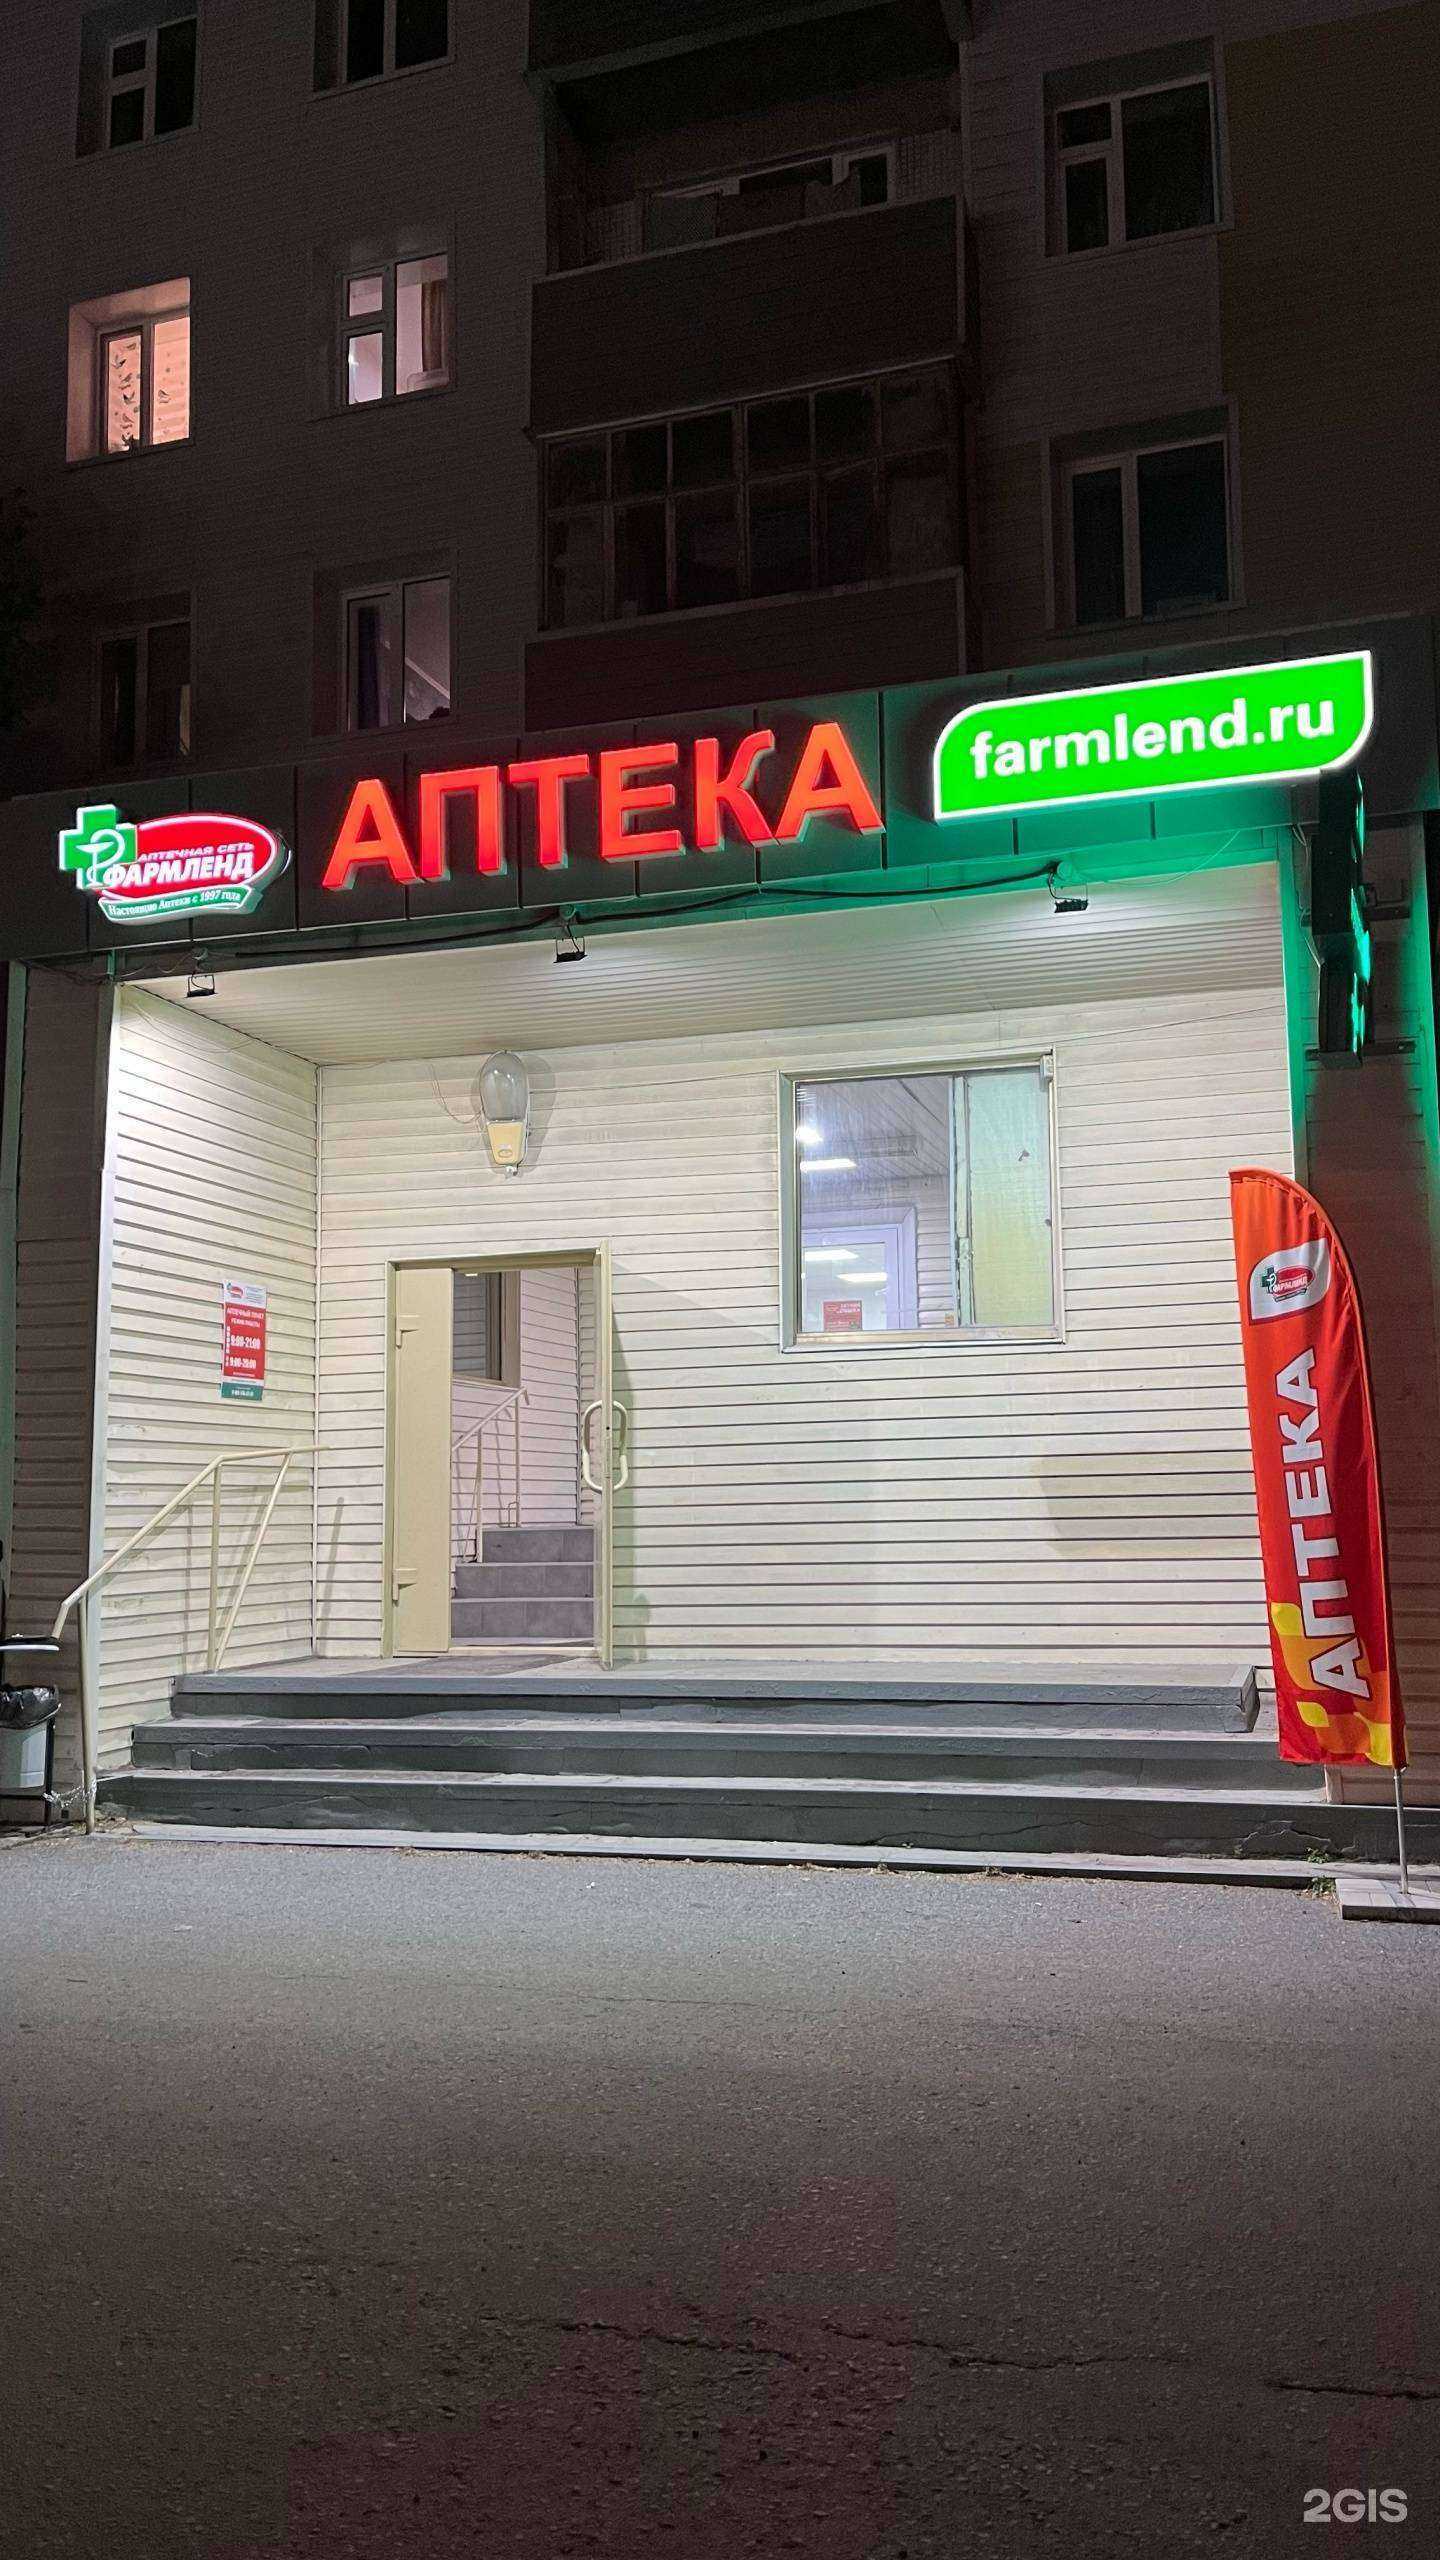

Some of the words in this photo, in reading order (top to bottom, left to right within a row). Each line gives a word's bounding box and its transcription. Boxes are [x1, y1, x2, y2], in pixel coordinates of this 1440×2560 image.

[969, 697, 1335, 780] farmlend.ru
[321, 722, 886, 891] АПТЕКА
[102, 851, 255, 888] ФАРМЛЕНД
[138, 846, 214, 863] АПТЕЧНАЯ
[216, 842, 255, 854] СЕТЬ
[200, 889, 221, 902] 1997
[222, 891, 241, 901] года
[1275, 1347, 1371, 1699] АПТЕКА
